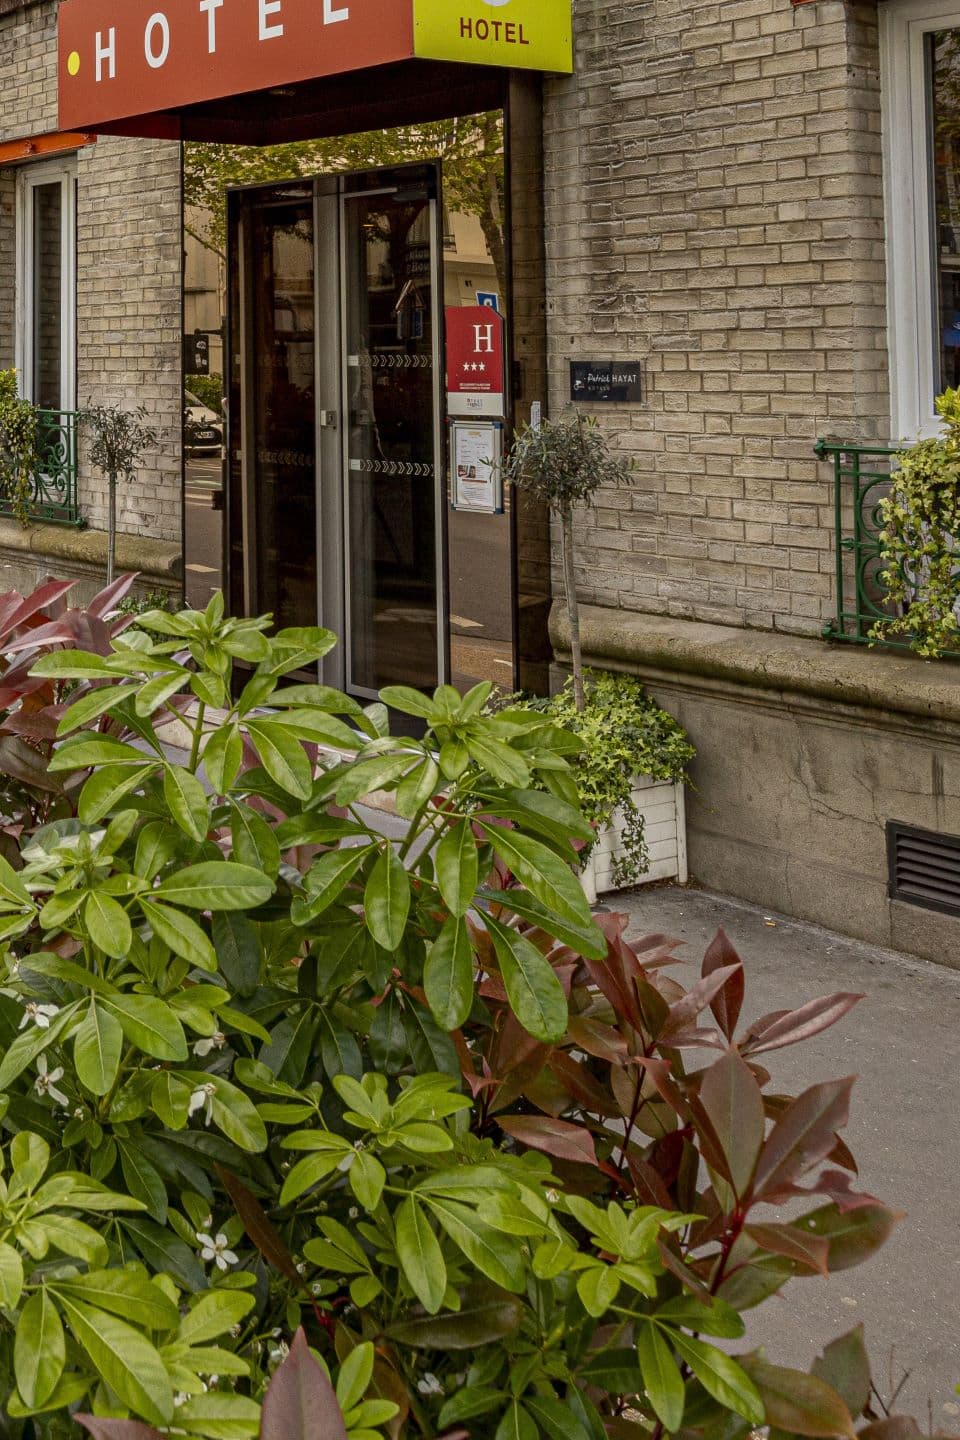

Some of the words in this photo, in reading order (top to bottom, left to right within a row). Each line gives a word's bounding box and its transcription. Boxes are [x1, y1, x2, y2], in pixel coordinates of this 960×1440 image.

[460, 17, 529, 44] HOTEL
[472, 324, 495, 353] H
[611, 374, 637, 384] HAYAT
